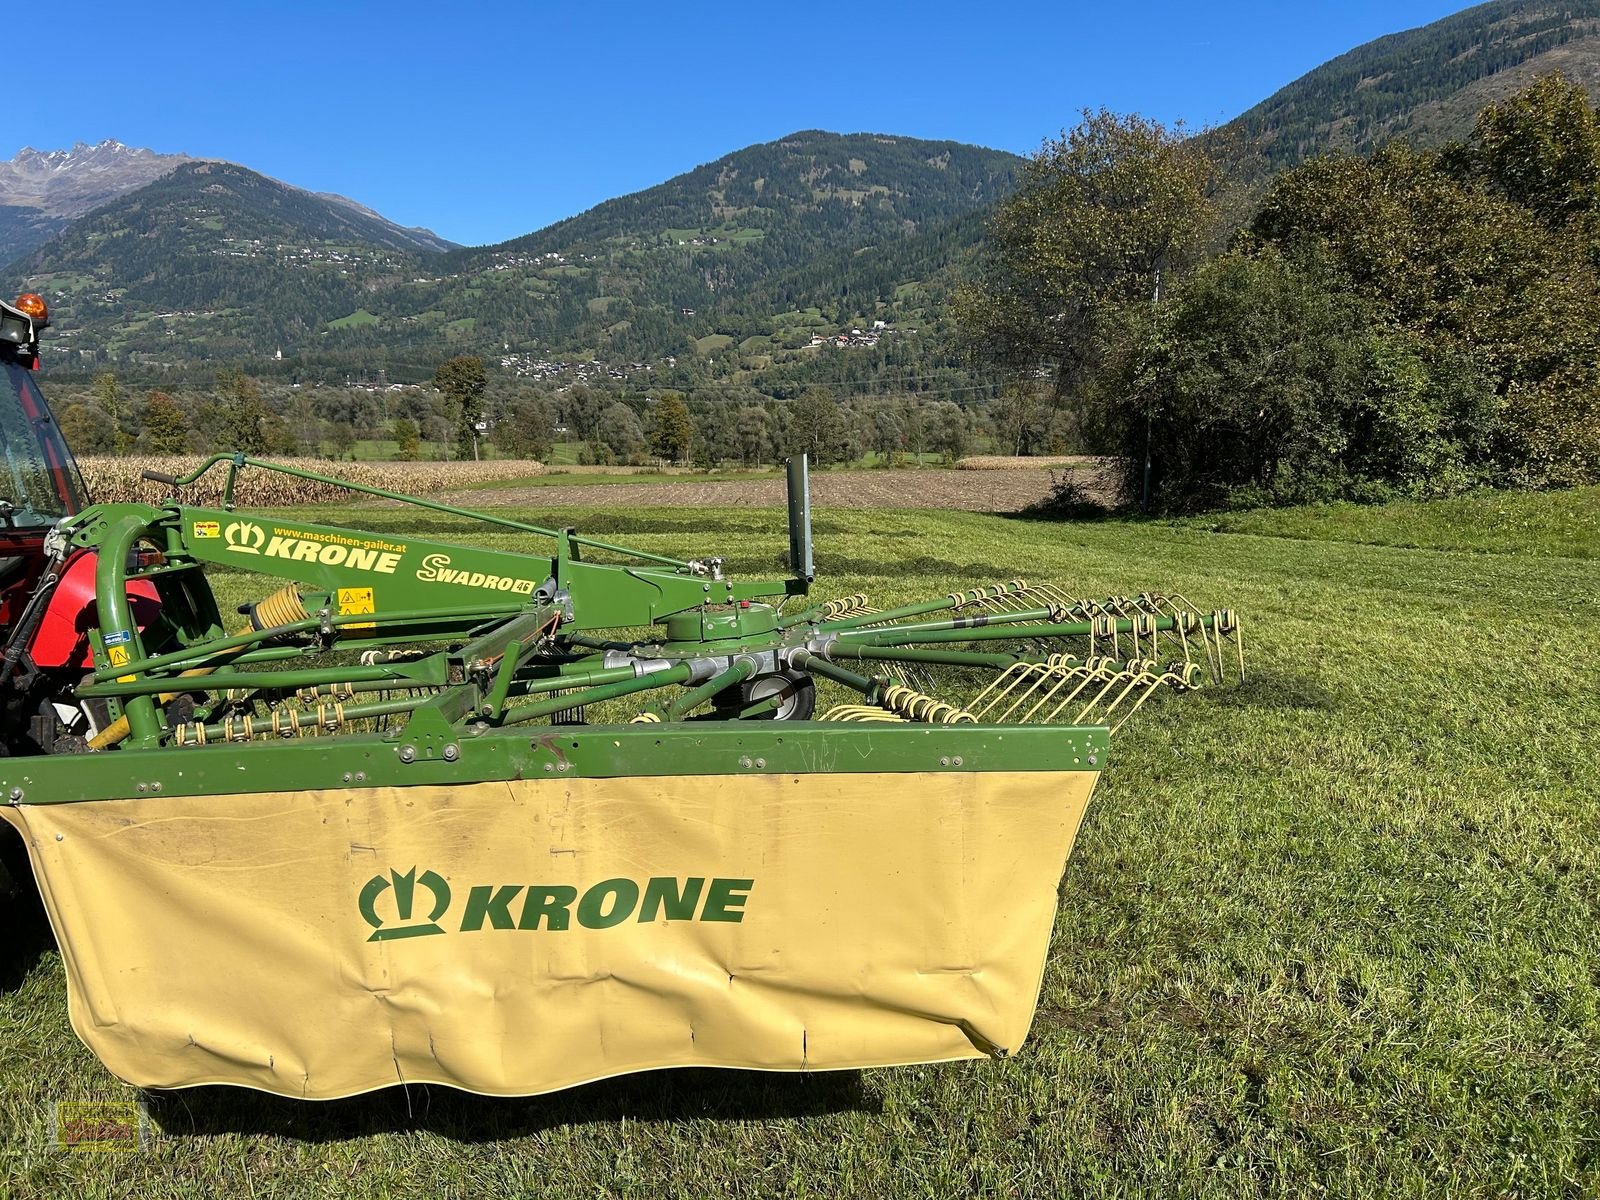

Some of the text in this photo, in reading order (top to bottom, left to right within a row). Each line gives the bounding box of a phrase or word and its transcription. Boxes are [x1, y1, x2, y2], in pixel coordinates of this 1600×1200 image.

[264, 536, 402, 574] KRONE
[274, 527, 406, 553] www.maschinen-gailer.at
[459, 876, 755, 932] KRONE
